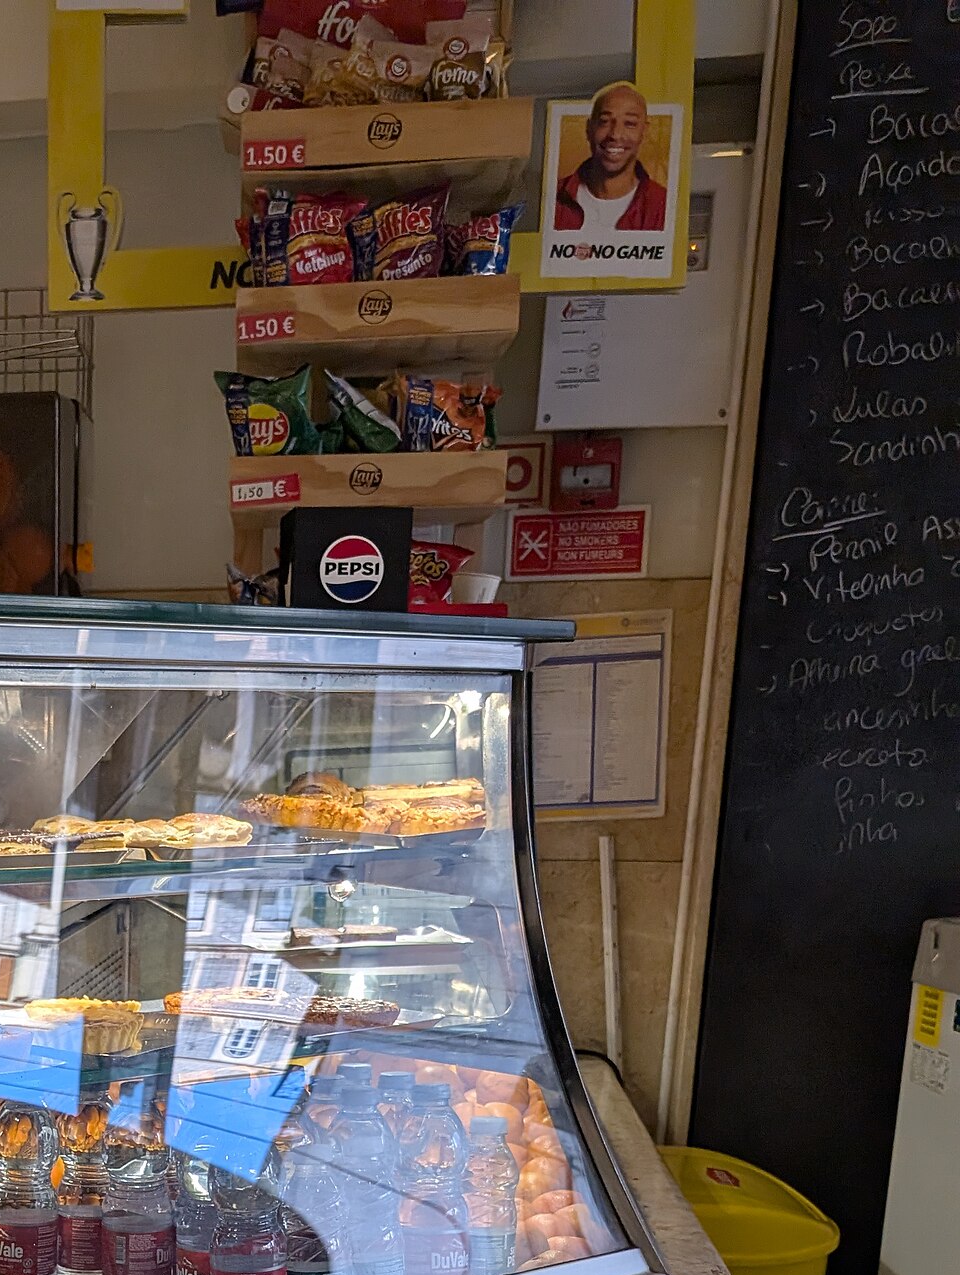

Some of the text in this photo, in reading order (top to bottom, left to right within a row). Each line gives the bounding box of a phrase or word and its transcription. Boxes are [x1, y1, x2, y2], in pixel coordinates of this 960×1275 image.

[433, 59, 478, 84] Forno
[245, 144, 305, 167] 1.50 €
[549, 244, 575, 259] NO
[591, 244, 615, 260] NO
[617, 245, 666, 260] GAME
[296, 250, 346, 276] Ketchup
[383, 251, 433, 281] Presunto
[240, 315, 296, 340] 1.50 €
[431, 417, 472, 442] ritos
[579, 519, 638, 532] FUMADORES
[557, 535, 620, 547] NO SMOKERS
[557, 550, 624, 562] NON FUMEURS
[324, 561, 380, 577] PEPSI
[431, 1250, 469, 1270] DuVale
